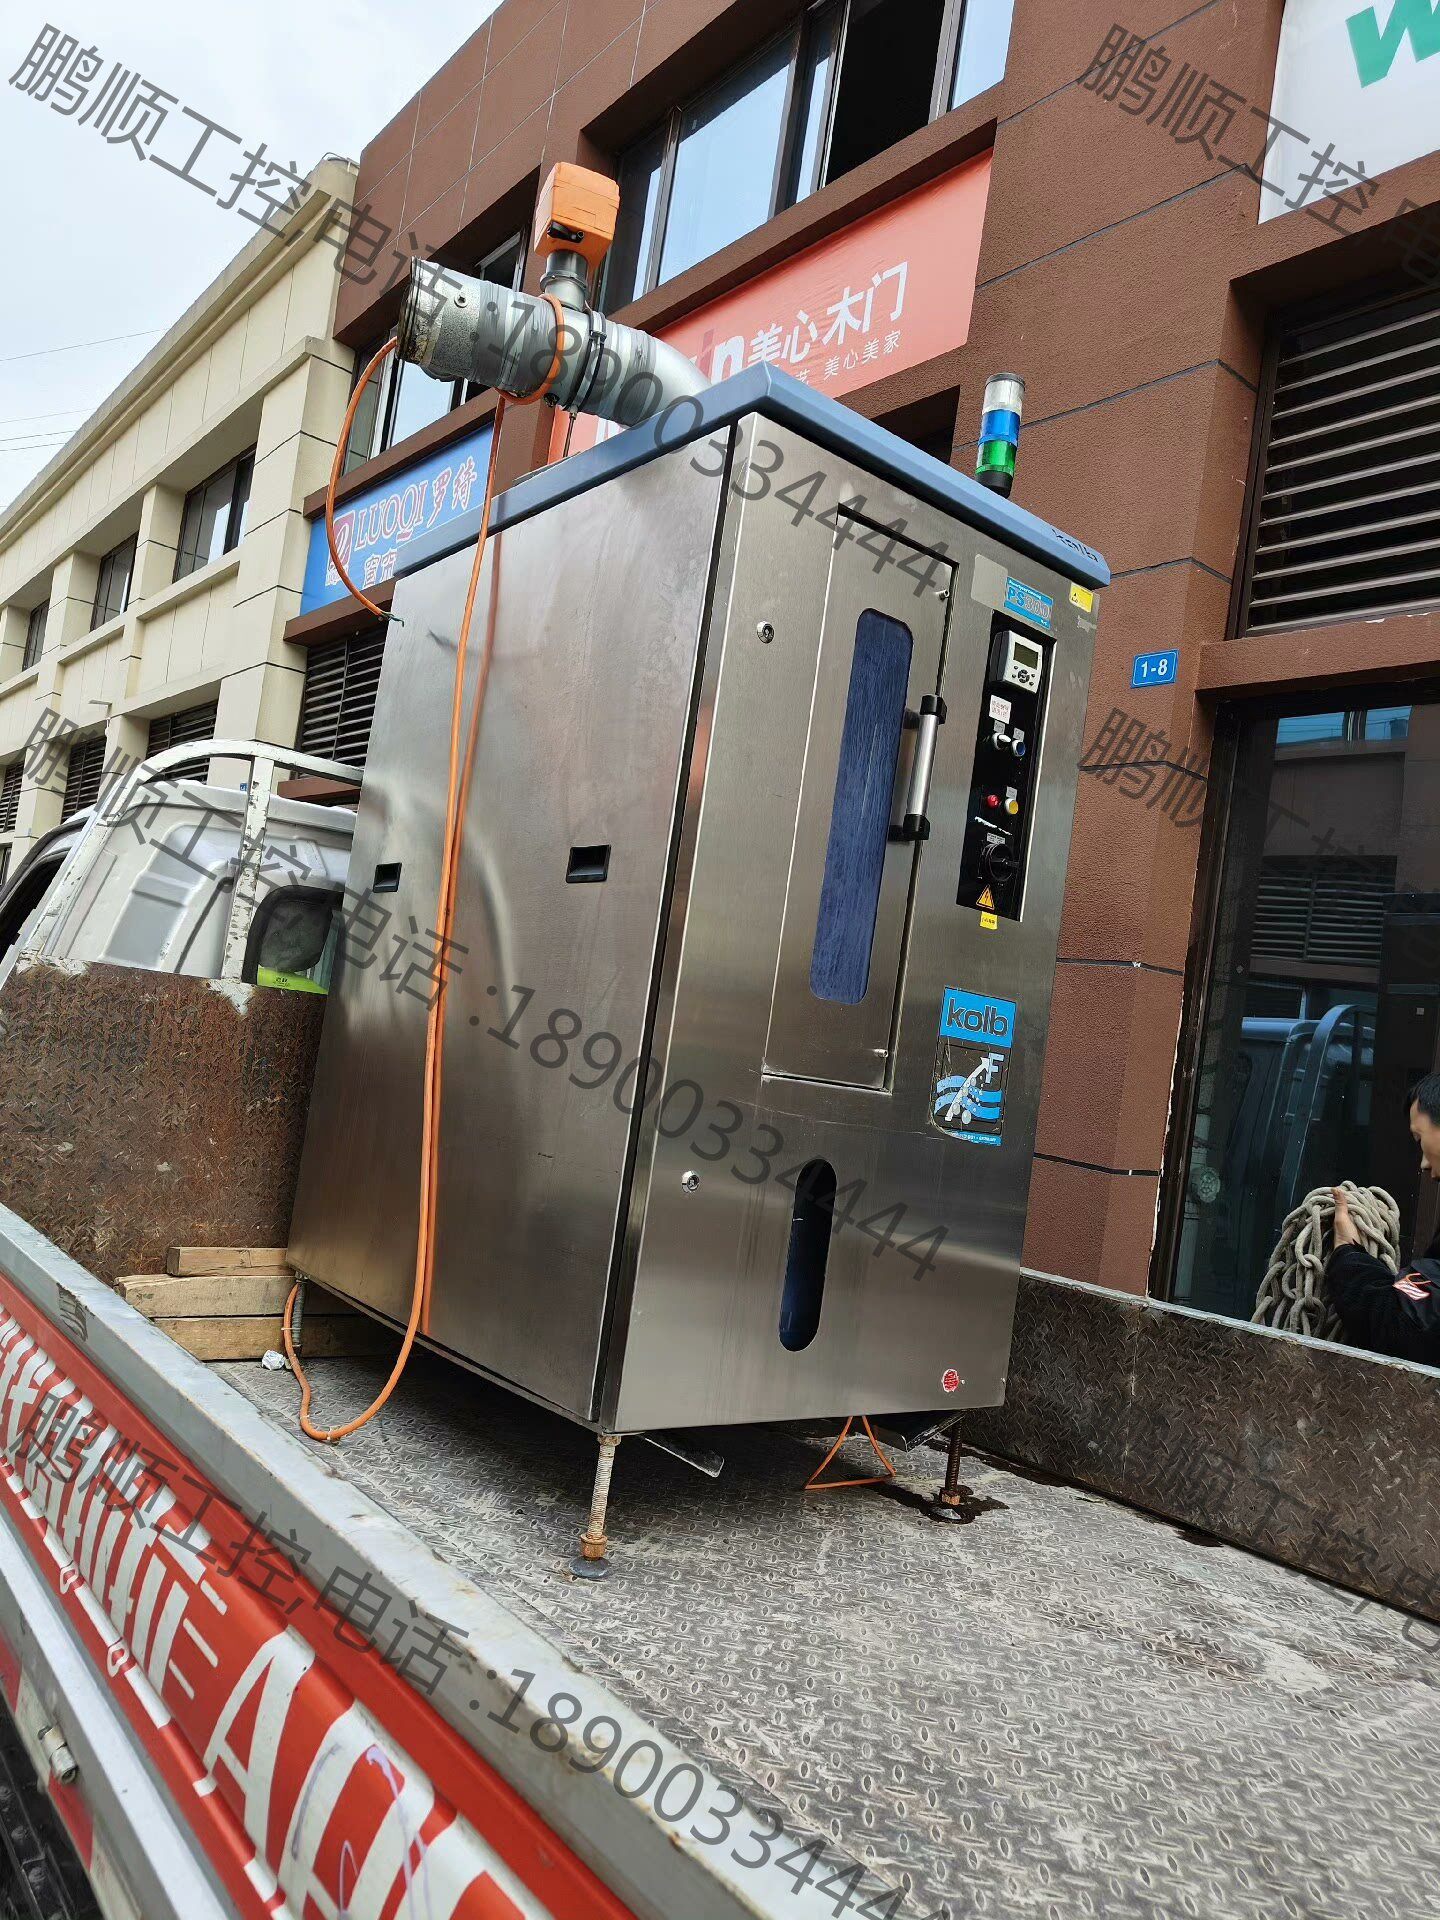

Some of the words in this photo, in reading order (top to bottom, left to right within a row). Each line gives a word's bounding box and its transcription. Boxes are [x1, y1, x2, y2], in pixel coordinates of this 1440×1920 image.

[748, 261, 908, 364] 美心木门
[823, 330, 901, 381] 美心美家
[354, 480, 429, 552] LUOQI
[1140, 658, 1168, 678] 1-8
[946, 998, 1009, 1037] kolb
